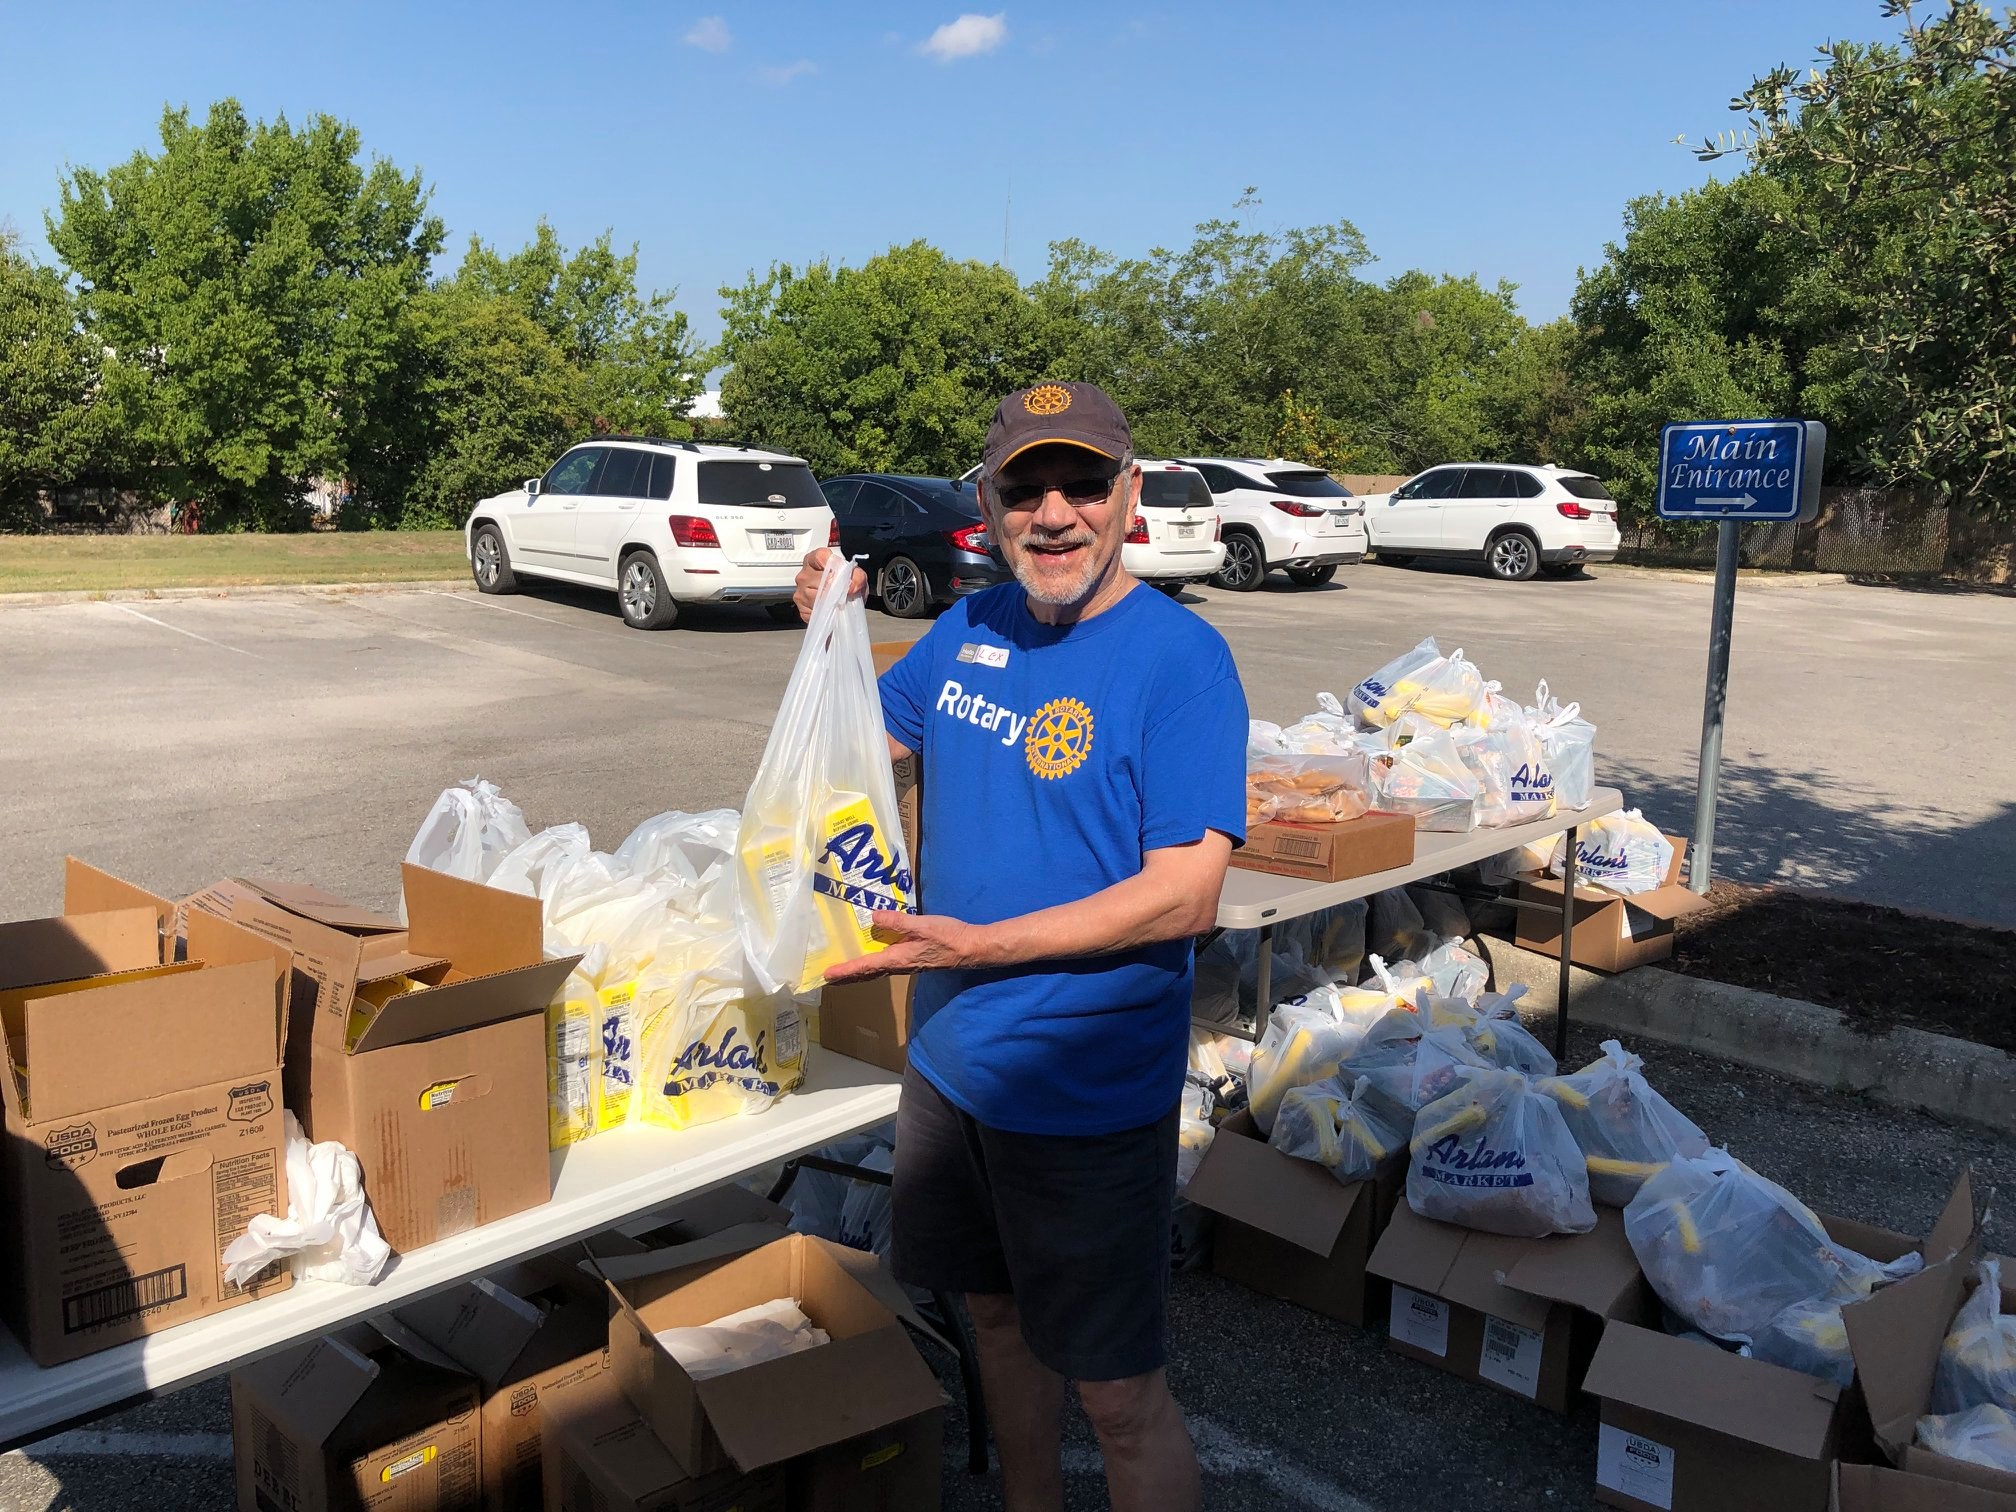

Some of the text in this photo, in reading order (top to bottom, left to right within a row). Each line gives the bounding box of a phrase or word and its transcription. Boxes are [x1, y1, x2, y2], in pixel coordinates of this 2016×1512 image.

[1684, 433, 1779, 461] Main
[1671, 463, 1790, 489] Entrance
[936, 679, 1027, 747] Rotary
[1054, 704, 1083, 721] ROTARY
[1030, 743, 1077, 771] INTERNATIONAL
[107, 1105, 219, 1138] Pasteurized Frozen Egg Product
[50, 1127, 92, 1144] USDA
[136, 1121, 193, 1140] WHOLE EGGS
[50, 1140, 93, 1156] FOOD
[219, 1157, 250, 1170] Nutrition
[251, 1151, 271, 1162] Facts
[1434, 1170, 1519, 1187] MARKET
[134, 1193, 147, 1202] LLC
[512, 1385, 535, 1400] USDA
[513, 1394, 536, 1409] FOOD
[1629, 1436, 1657, 1453] USDA
